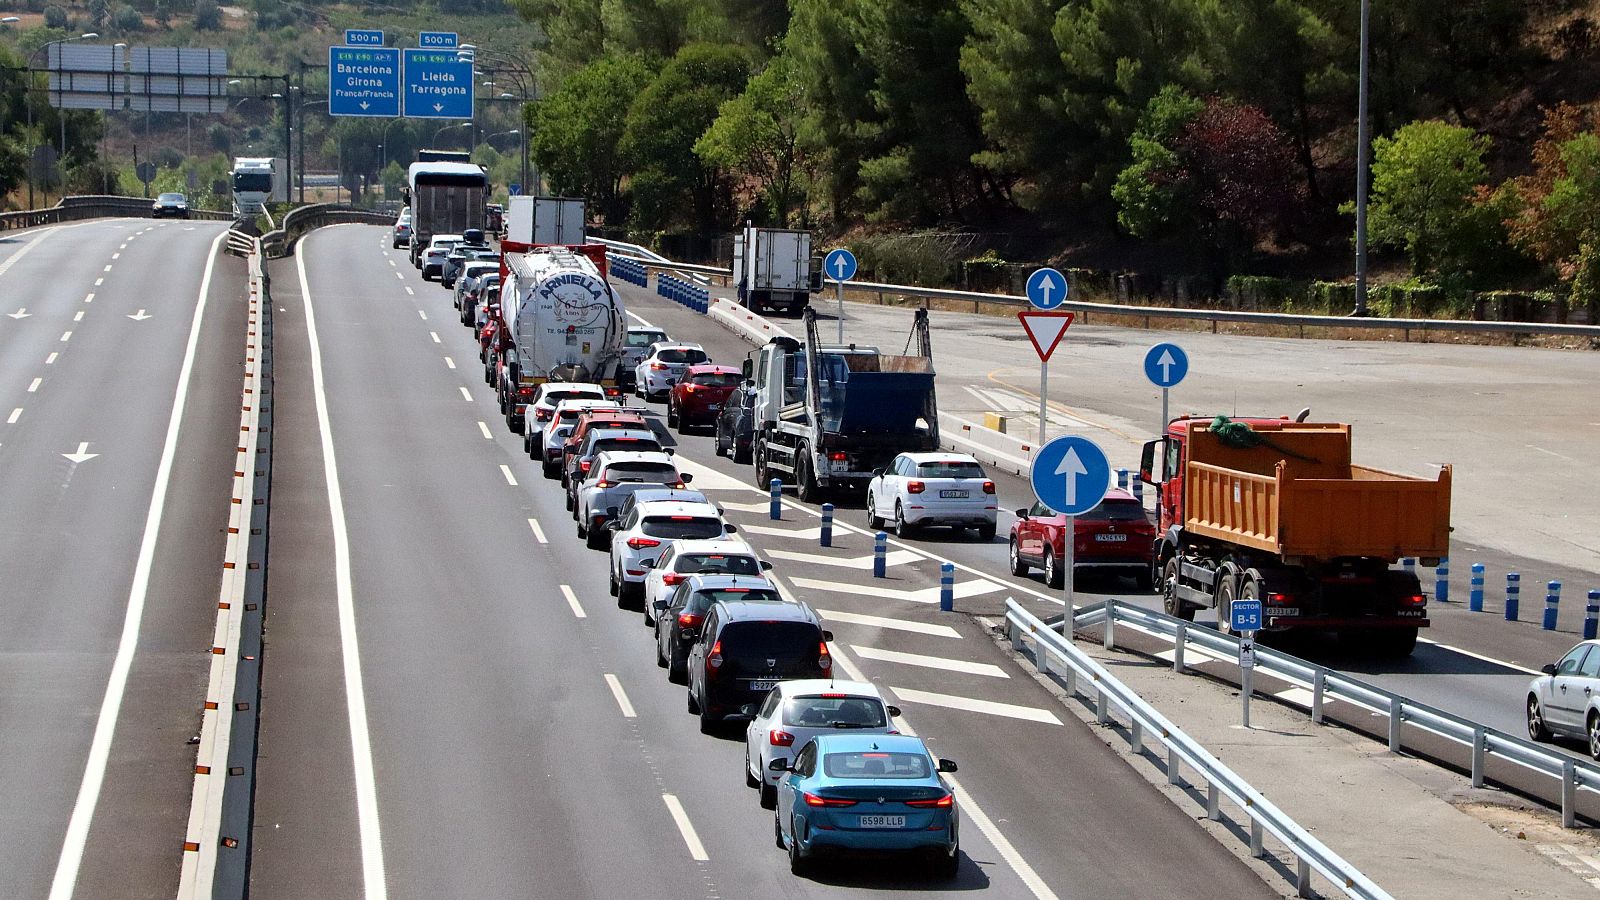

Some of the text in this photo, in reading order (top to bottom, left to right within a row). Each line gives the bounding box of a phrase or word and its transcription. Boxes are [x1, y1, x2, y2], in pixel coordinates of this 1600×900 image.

[350, 34, 369, 42] 500
[424, 36, 443, 44] 500
[337, 64, 392, 75] Barcelona
[347, 77, 383, 87] Girona
[422, 72, 455, 82] Lleida
[411, 84, 467, 97] Tarragona
[540, 274, 602, 300] ARNIELLA
[1237, 614, 1257, 625] B-5
[862, 816, 903, 826] 6598 LLB
